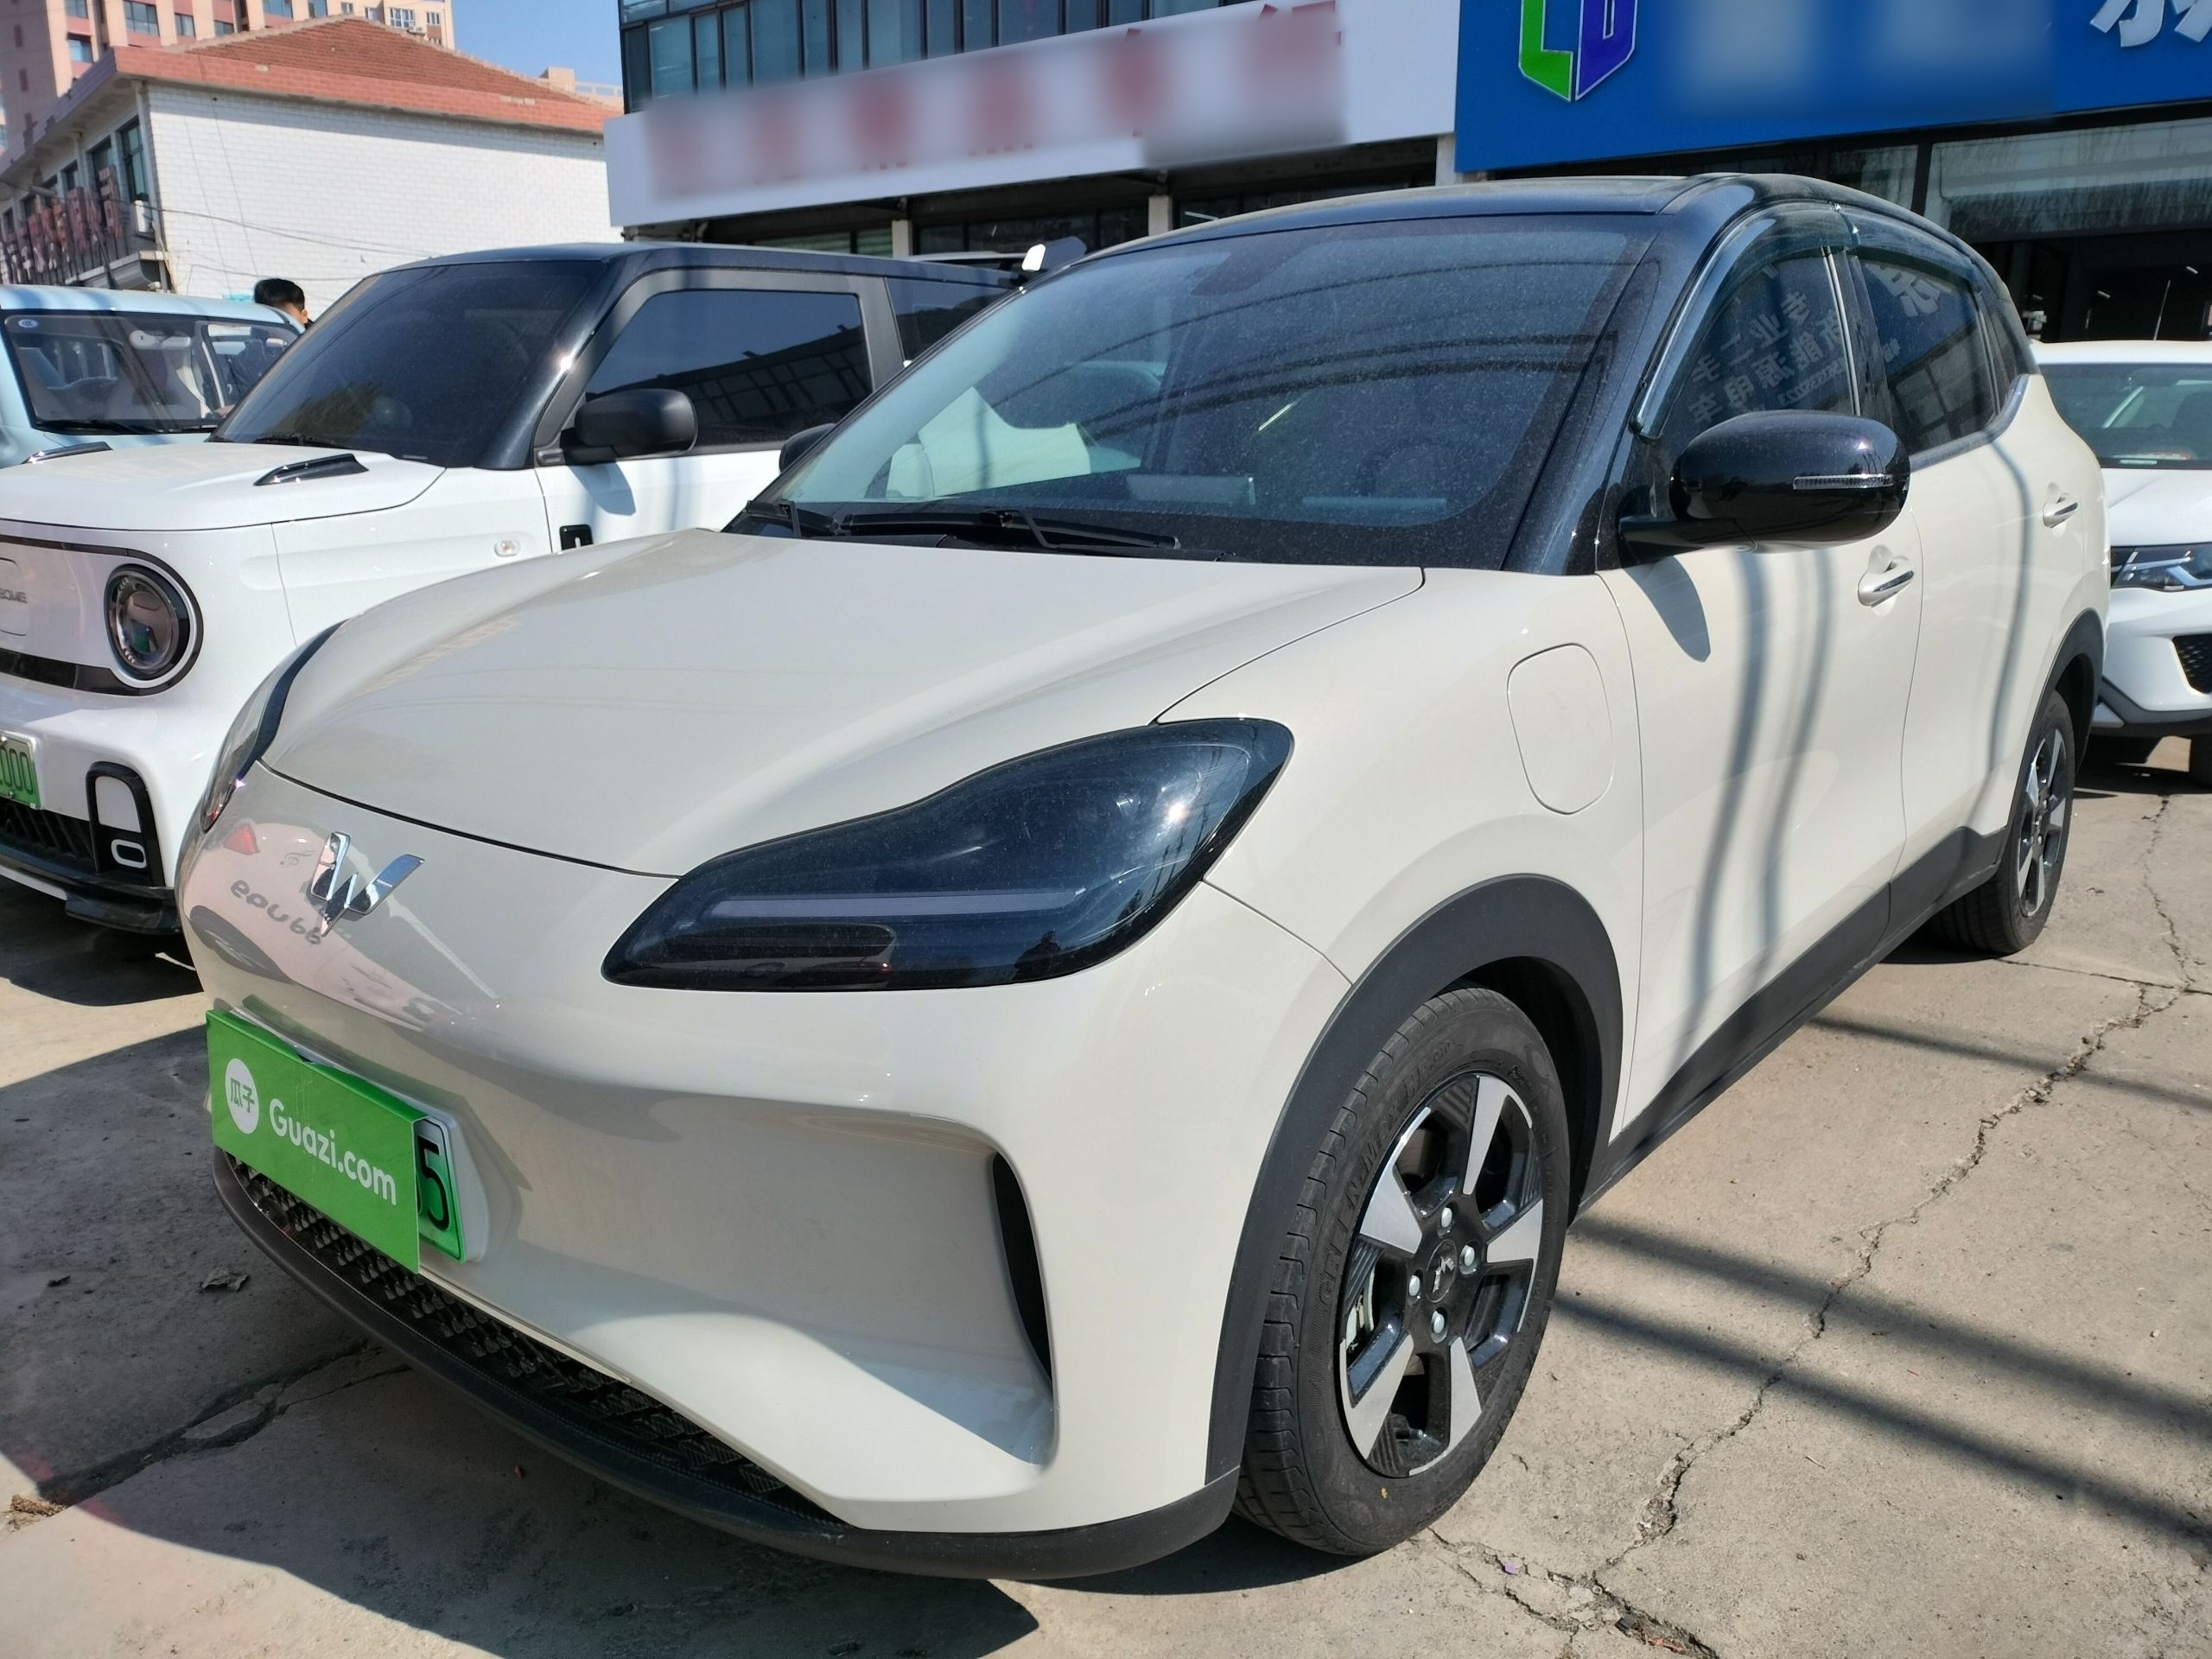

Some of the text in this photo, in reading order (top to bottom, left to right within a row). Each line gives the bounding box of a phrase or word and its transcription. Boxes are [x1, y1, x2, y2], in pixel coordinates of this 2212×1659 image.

[230, 1077, 256, 1114] 瓜子
[269, 1098, 397, 1206] Guazi.com
[415, 1134, 450, 1231] 5
